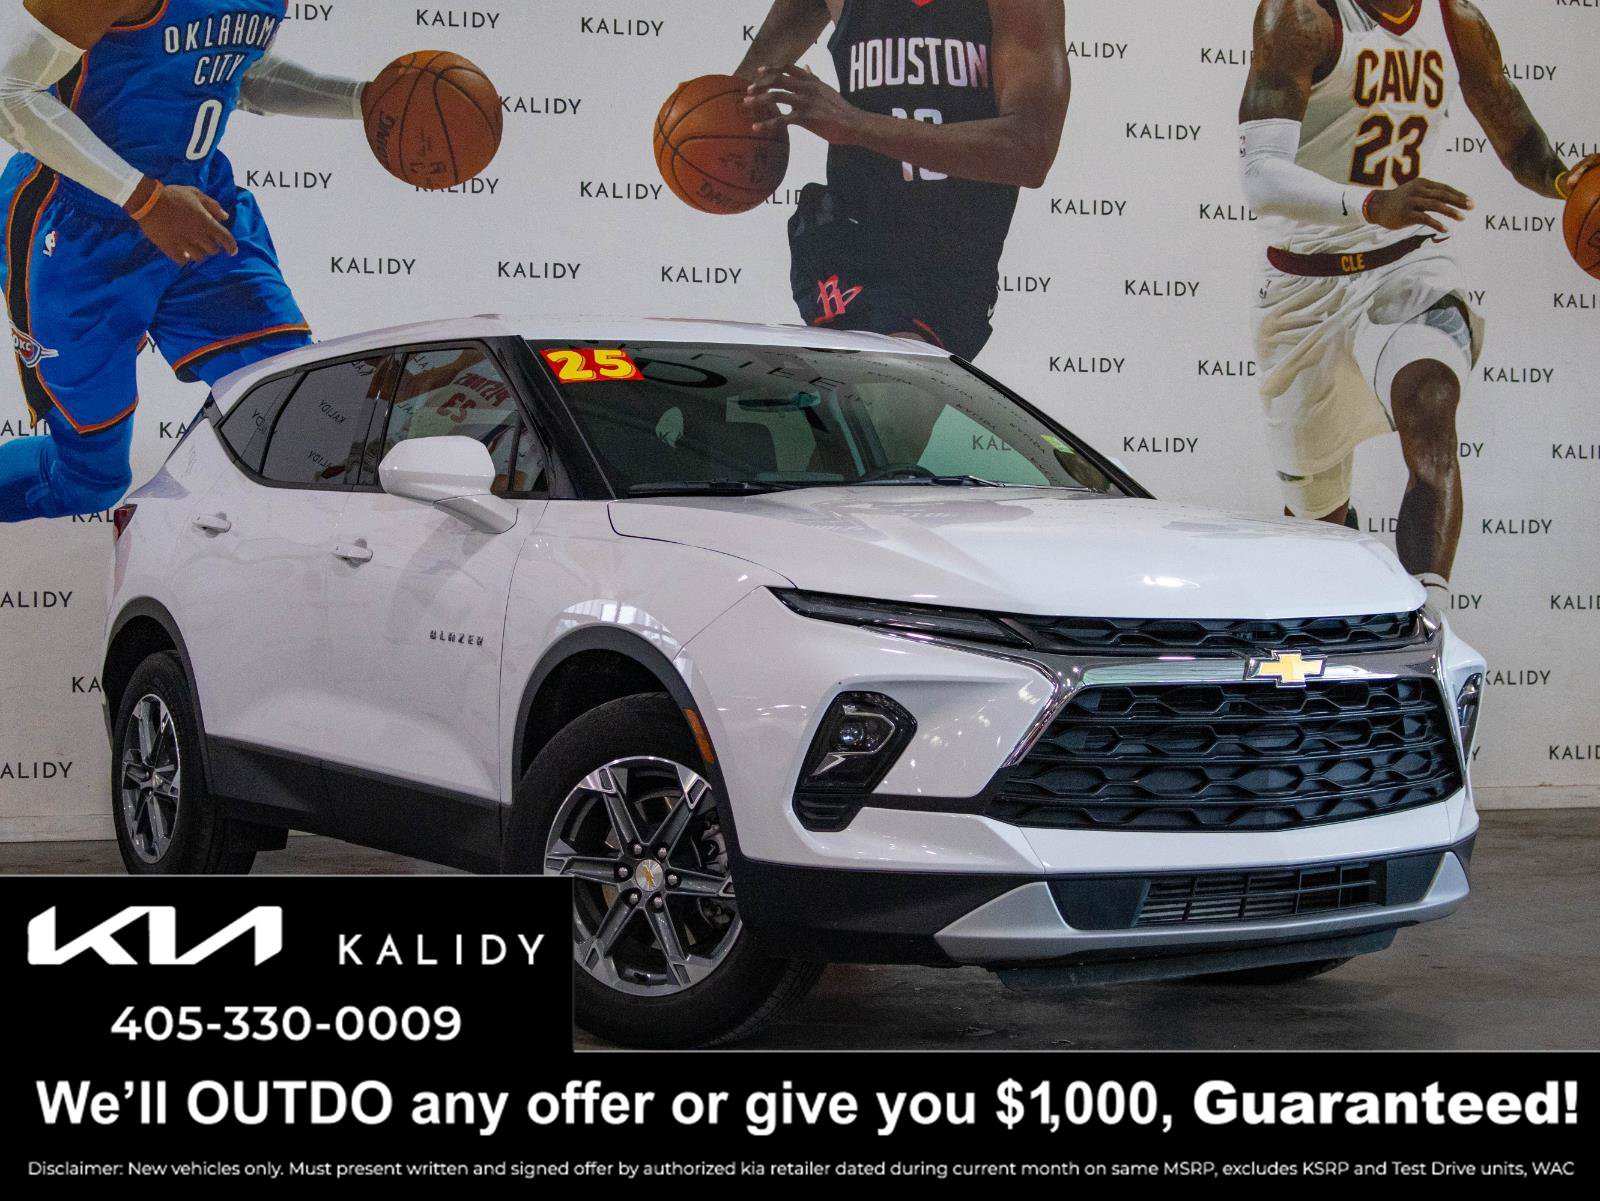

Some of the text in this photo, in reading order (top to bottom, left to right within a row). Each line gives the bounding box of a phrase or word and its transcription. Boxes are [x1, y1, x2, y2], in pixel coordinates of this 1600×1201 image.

[283, 4, 334, 22] IDY
[416, 9, 500, 29] KALIDY
[164, 13, 276, 54] OKLAHOM
[581, 17, 664, 37] KALIDY
[1066, 41, 1128, 60] ALIDY
[1201, 48, 1253, 65] KALI
[193, 54, 246, 86] CITY
[849, 37, 988, 92] HOUSTON
[1502, 64, 1557, 81] ALIDY
[1353, 48, 1444, 108] CAVS
[500, 96, 582, 115] KALIDY
[185, 98, 224, 162] 0
[1126, 123, 1201, 141] KALIDY
[1349, 113, 1429, 187] 23
[1446, 137, 1487, 154] IDY
[1555, 142, 1597, 158] KALI
[246, 170, 333, 190] KALIDY
[580, 181, 662, 200] KALIDY
[1051, 198, 1127, 216] KALIDY
[1486, 215, 1556, 232] KALIDY
[331, 257, 416, 275] KALIDY
[497, 261, 581, 279] KALIDY
[1341, 254, 1365, 272] CLE
[661, 266, 742, 284] KALIDY
[998, 276, 1051, 293] LIDY
[1125, 279, 1199, 297] KALIDY
[1553, 293, 1596, 308] KALI
[547, 350, 636, 380] 25
[1049, 357, 1125, 374] KALIDY
[1198, 360, 1256, 376] KALID
[1483, 367, 1554, 383] KALIDY
[972, 435, 1013, 451] KAL
[1123, 436, 1198, 453] KALIDY
[1552, 444, 1600, 459] KALI
[1368, 517, 1398, 533] LID
[1482, 519, 1552, 534] KALIDY
[0, 591, 73, 608] ALIDY
[1450, 594, 1482, 610] IDY
[1550, 595, 1600, 610] KALI
[429, 629, 484, 646] BLAZER
[0, 762, 73, 779] ALIDY
